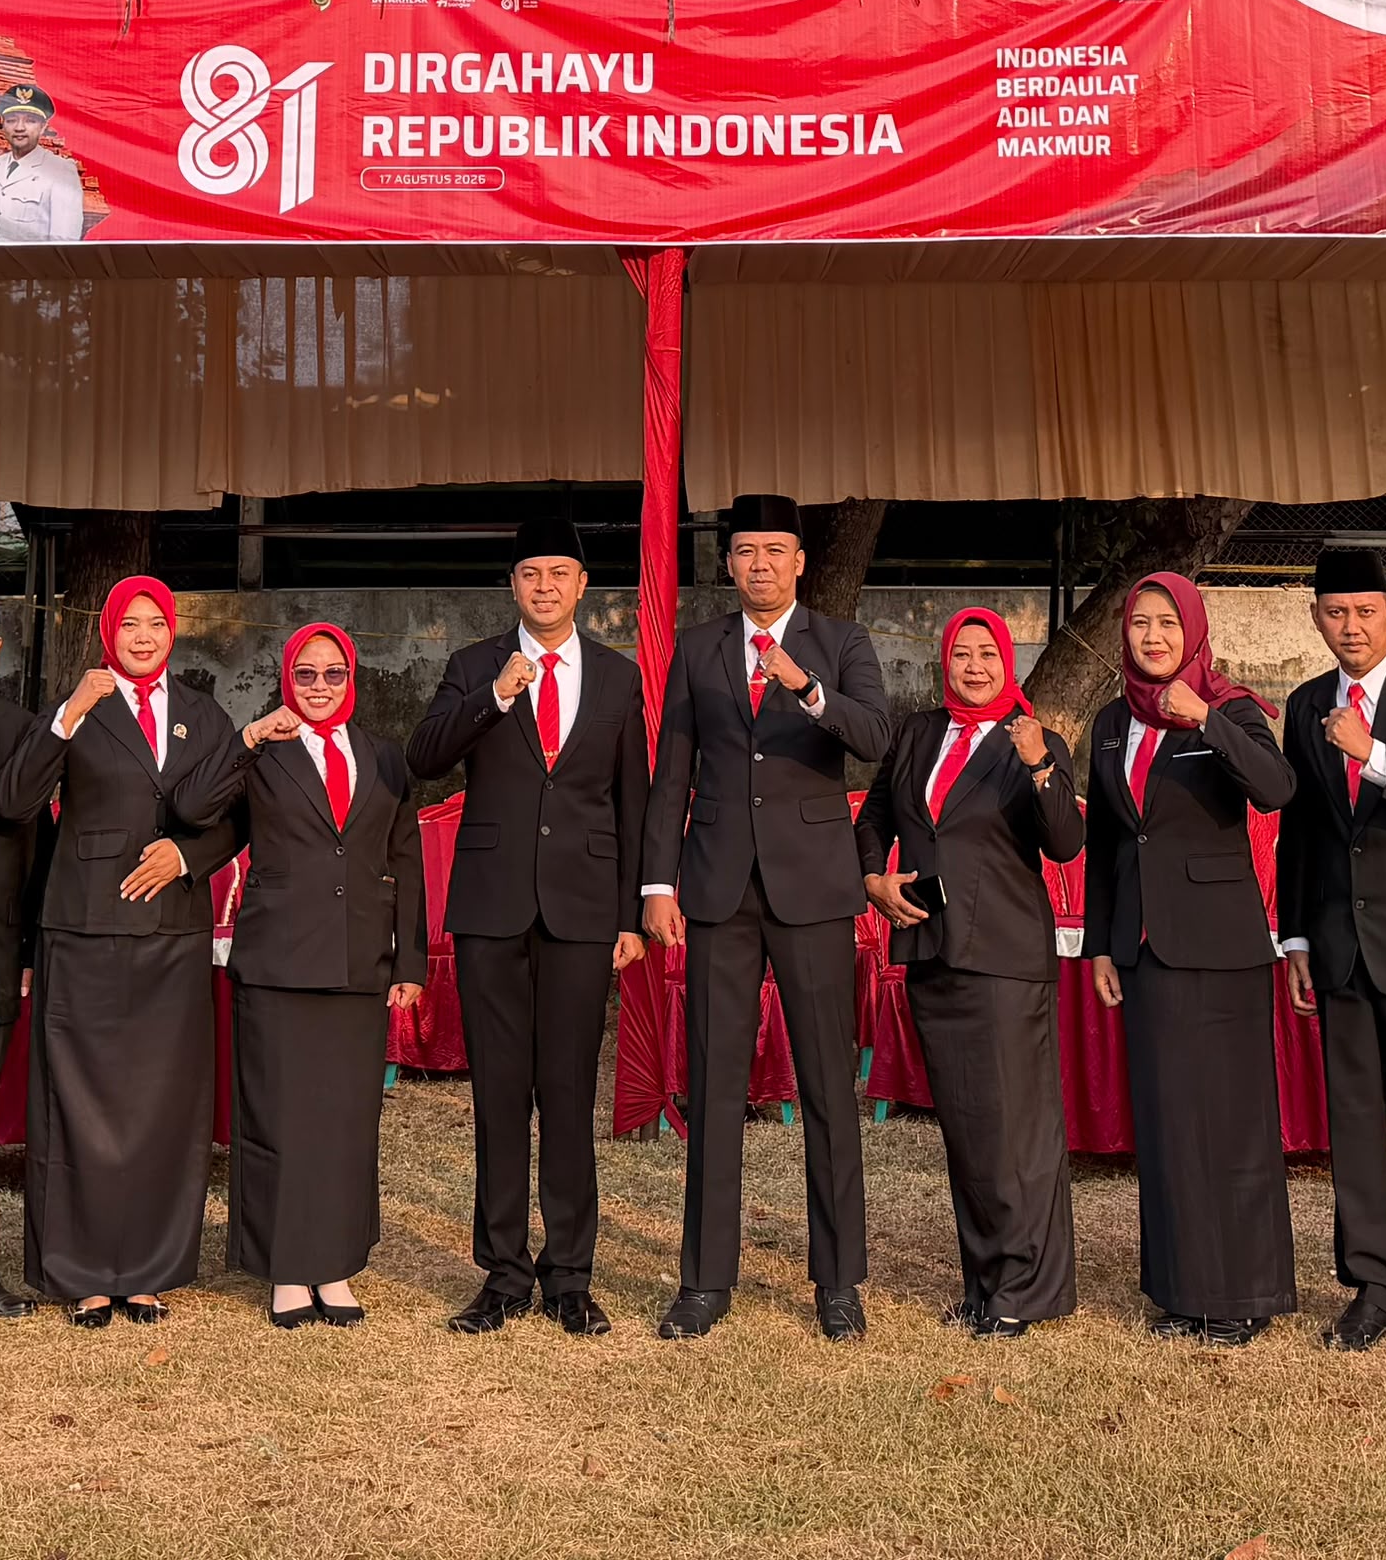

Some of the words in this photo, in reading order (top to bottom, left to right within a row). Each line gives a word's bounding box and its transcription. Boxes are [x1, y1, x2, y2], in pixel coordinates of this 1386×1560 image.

[996, 45, 1128, 68] INDONESIA
[364, 52, 654, 94] DIRGAHAYU
[996, 74, 1139, 98] BERDAULAT
[996, 104, 1052, 128] ADIL
[1058, 104, 1110, 127] DAN
[177, 44, 335, 215] 81
[363, 113, 611, 158] REPUBLIK
[626, 113, 904, 157] INDONESIA
[997, 135, 1111, 158] MAKMUR
[379, 174, 392, 185] 17
[394, 174, 452, 185] AGUSTUS
[454, 174, 486, 185] 2026
